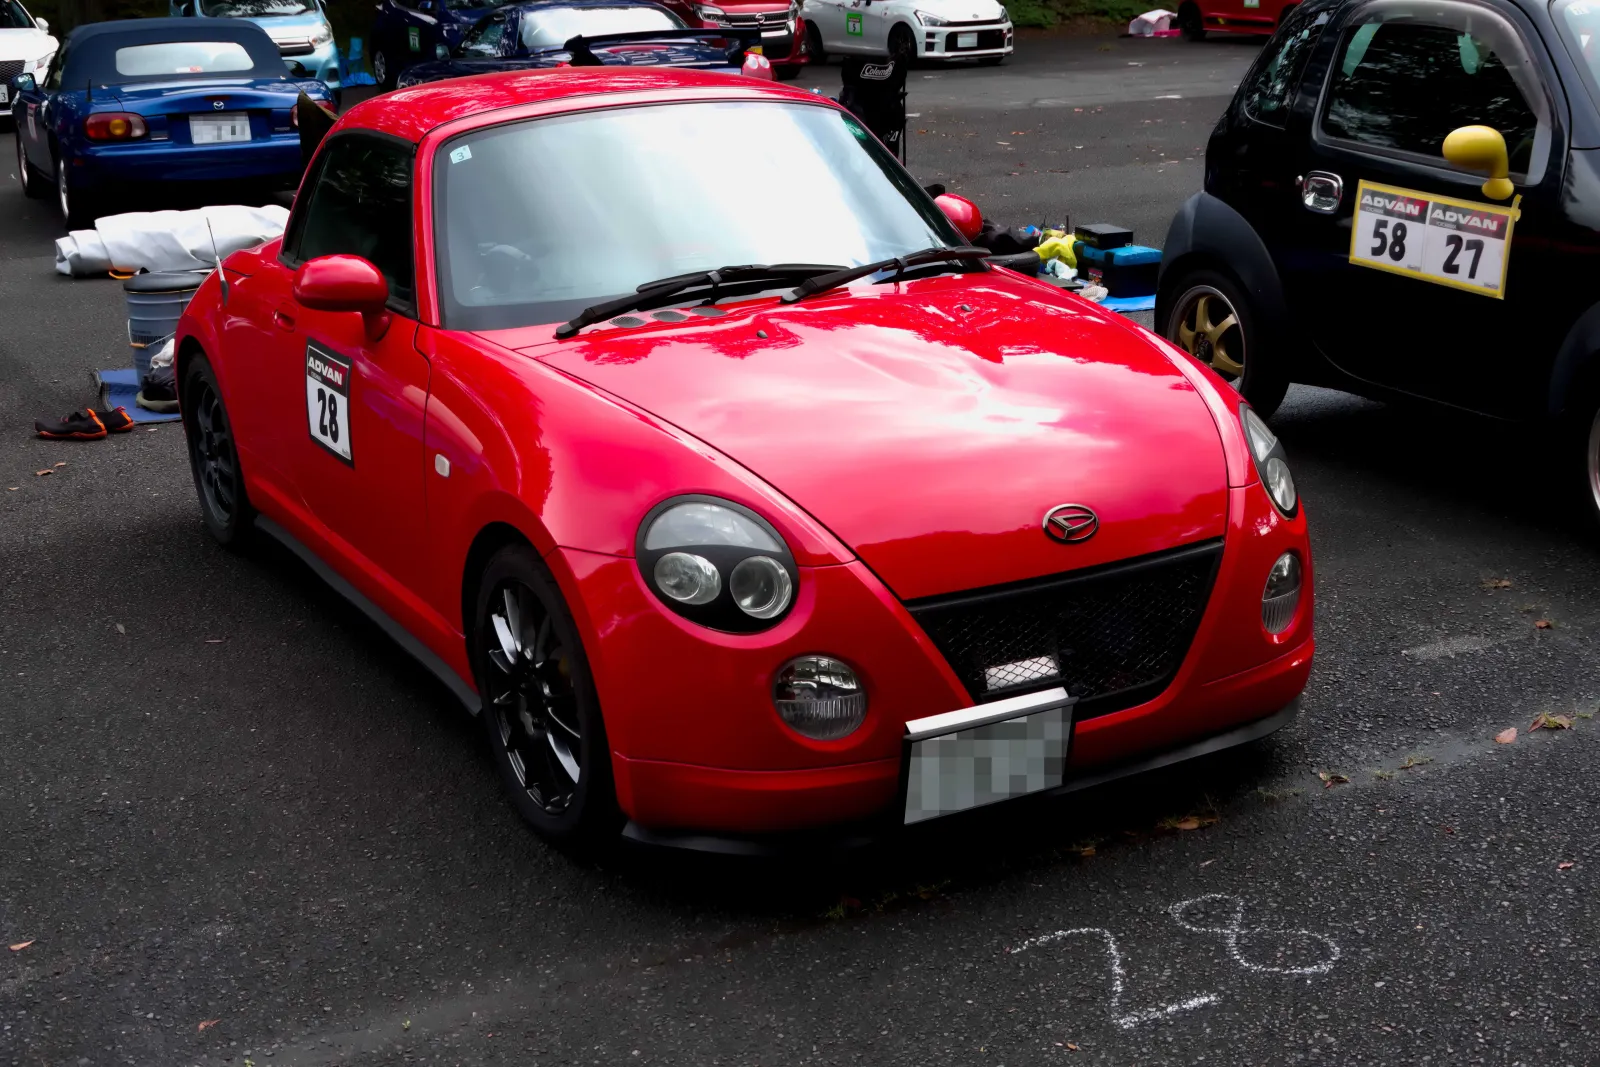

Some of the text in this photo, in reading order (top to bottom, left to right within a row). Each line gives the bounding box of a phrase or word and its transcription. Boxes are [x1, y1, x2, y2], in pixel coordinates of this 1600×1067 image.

[864, 64, 893, 76] Colem
[456, 152, 464, 160] 3
[1361, 194, 1420, 216] ADVAN
[1431, 209, 1498, 231] ADVAN
[1371, 218, 1408, 262] 58
[1442, 234, 1485, 280] 27
[308, 356, 343, 386] ADVAN
[317, 387, 340, 444] 28
[1011, 893, 1341, 1029] 28
